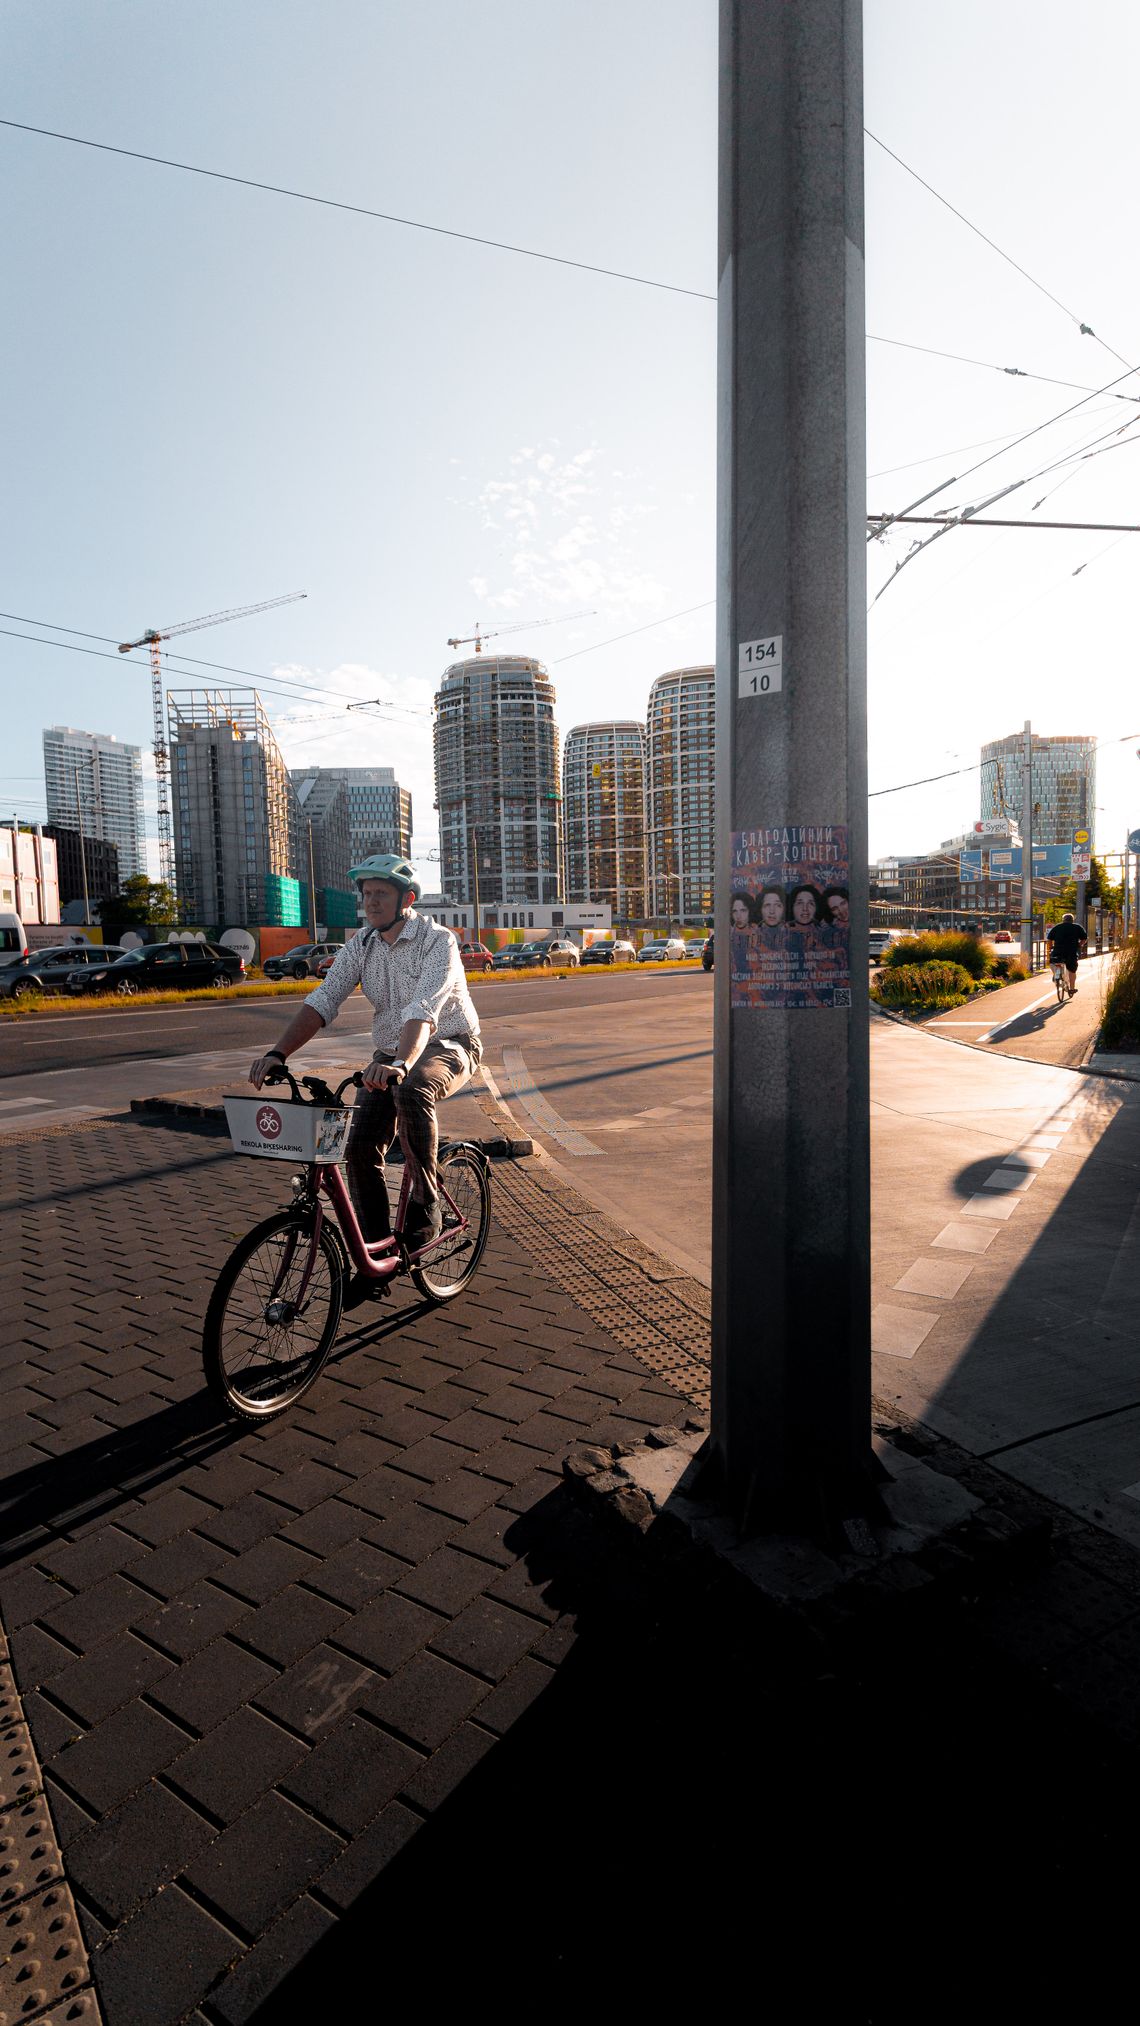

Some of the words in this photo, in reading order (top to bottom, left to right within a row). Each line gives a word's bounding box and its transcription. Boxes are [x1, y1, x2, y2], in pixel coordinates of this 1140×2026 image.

[745, 641, 776, 663] 154
[750, 674, 770, 693] 10
[985, 822, 1007, 832] Sygic
[741, 825, 833, 849] БЛАГОДІЙНИЙ
[240, 1140, 262, 1148] REKOLA
[263, 1143, 302, 1152] BIKESHARING
